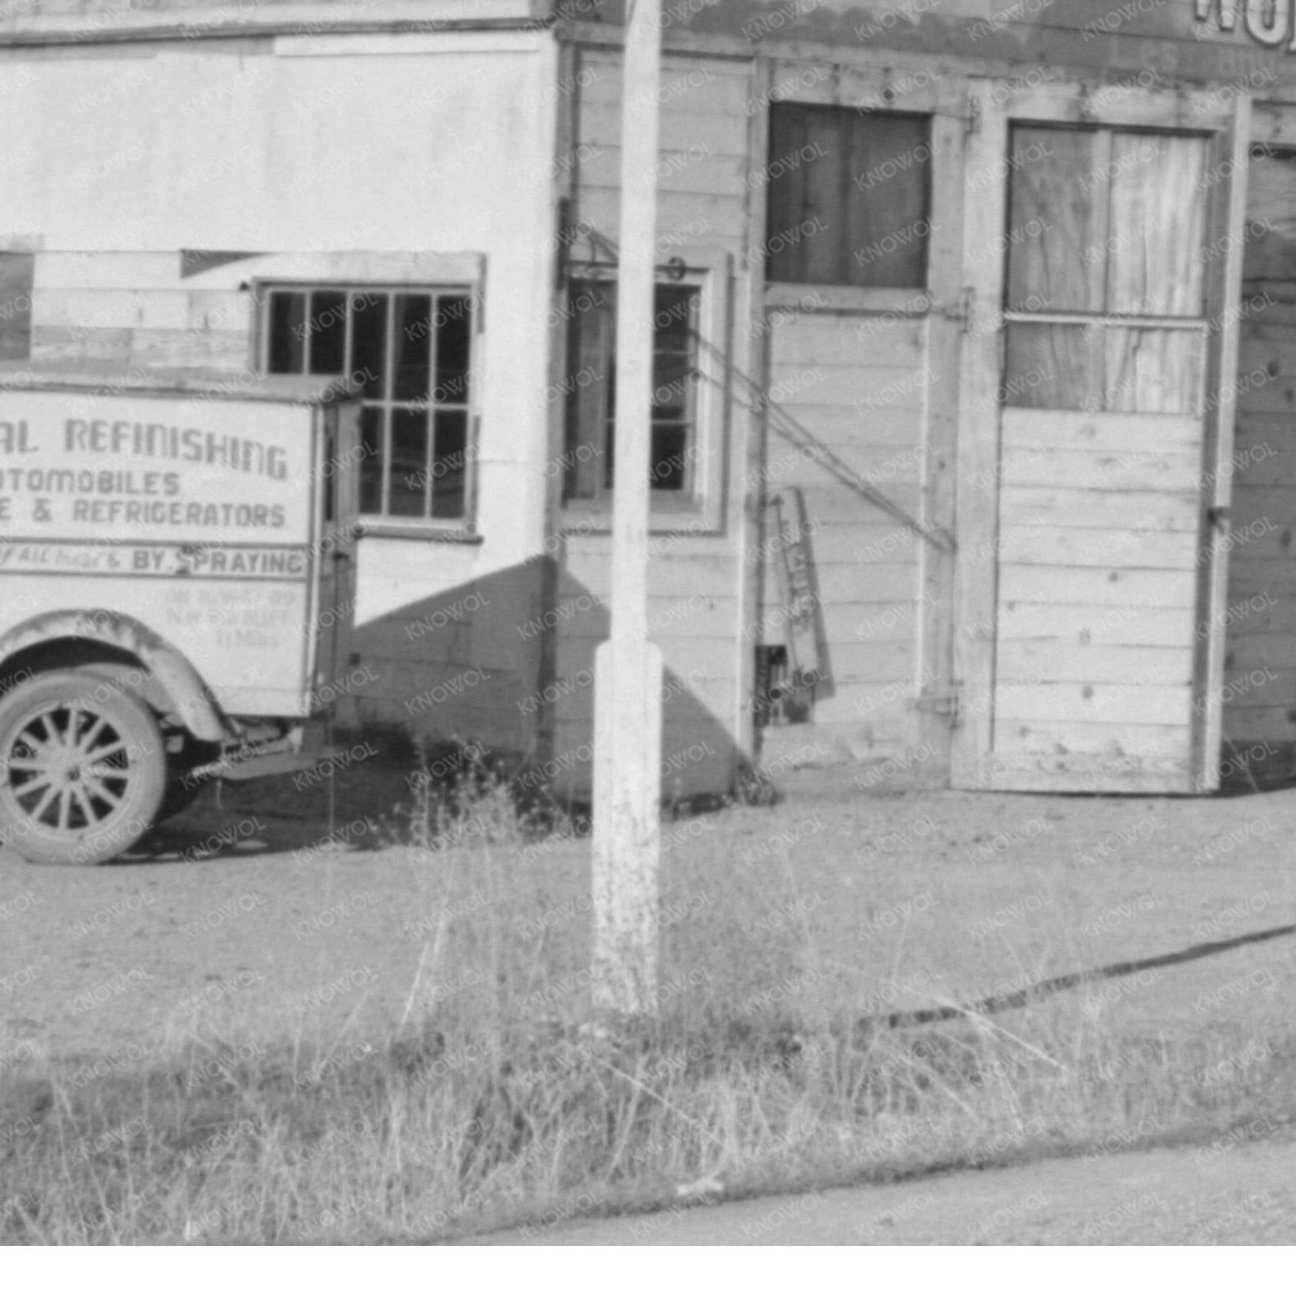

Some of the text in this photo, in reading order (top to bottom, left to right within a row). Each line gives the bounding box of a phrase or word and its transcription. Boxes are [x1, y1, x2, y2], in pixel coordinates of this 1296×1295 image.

[64, 418, 287, 481] REFINISHING
[31, 499, 52, 522] &
[72, 504, 285, 528] REFRIGERATORS
[176, 547, 303, 574] SPRAYING
